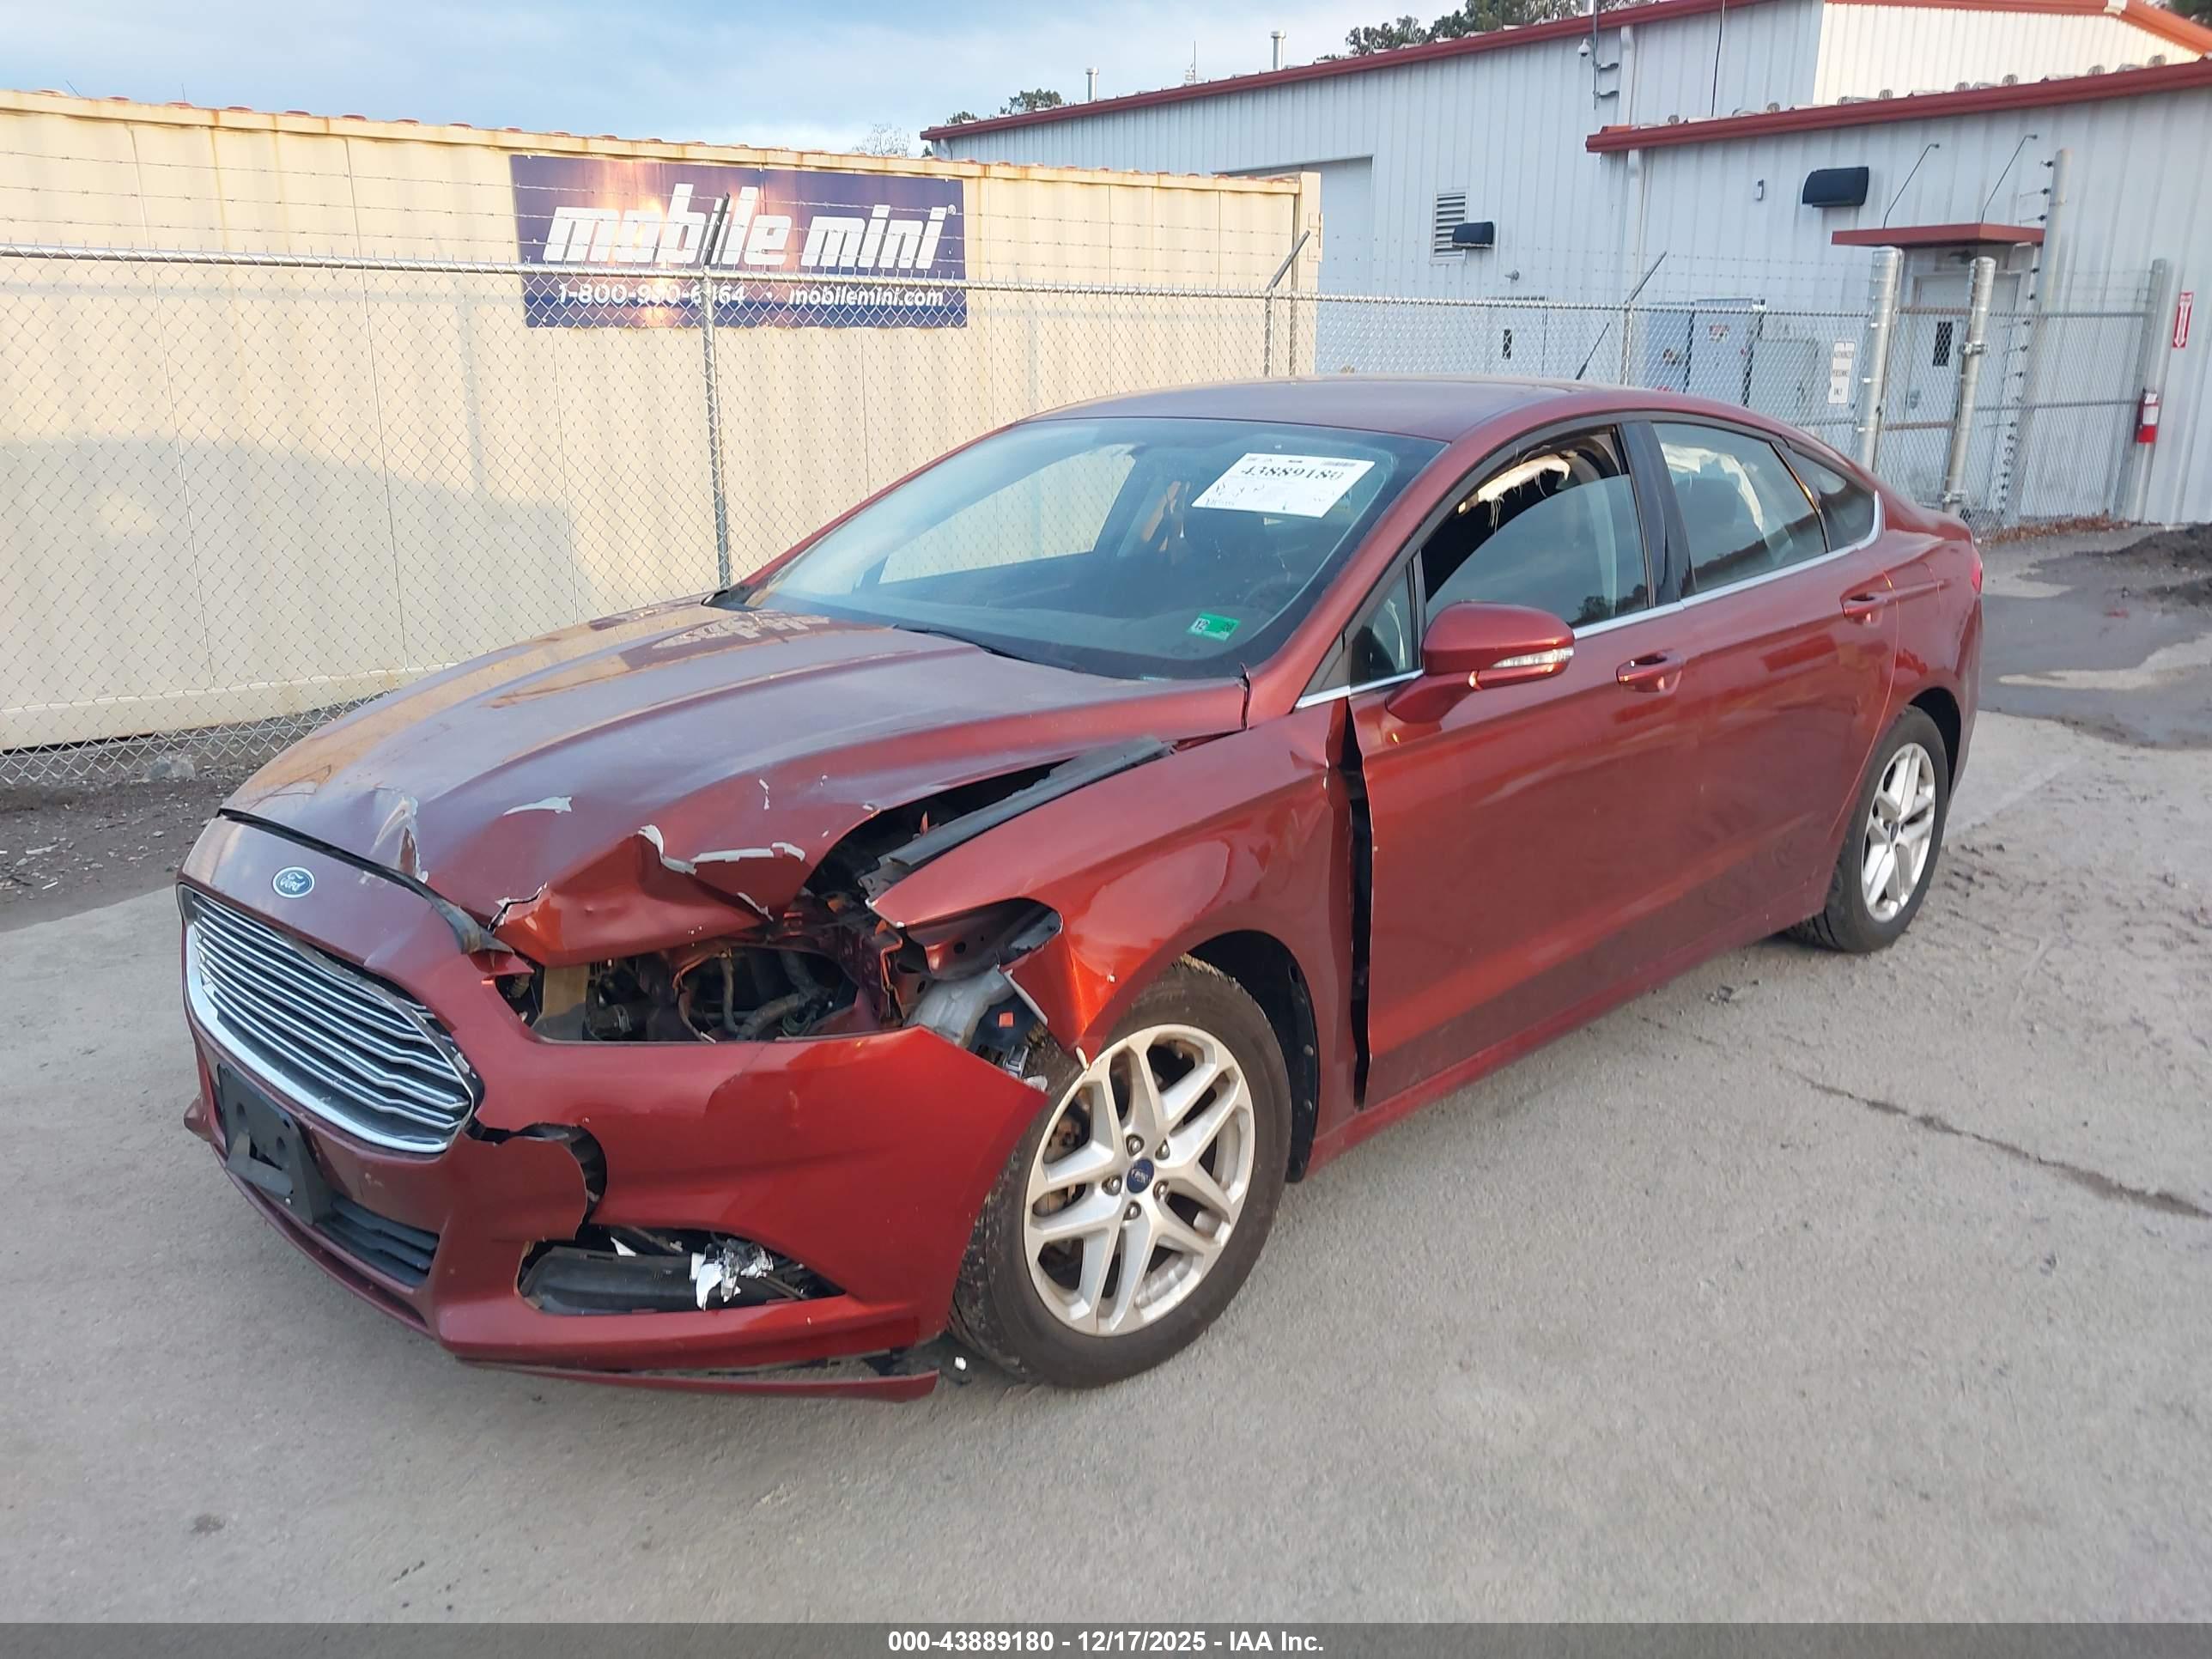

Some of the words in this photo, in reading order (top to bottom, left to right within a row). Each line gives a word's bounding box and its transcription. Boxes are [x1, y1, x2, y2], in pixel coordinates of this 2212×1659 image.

[542, 183, 793, 264] mobile
[800, 204, 948, 269] mini
[558, 283, 745, 304] 1-800-90-664
[789, 286, 944, 306] mobilemini.com
